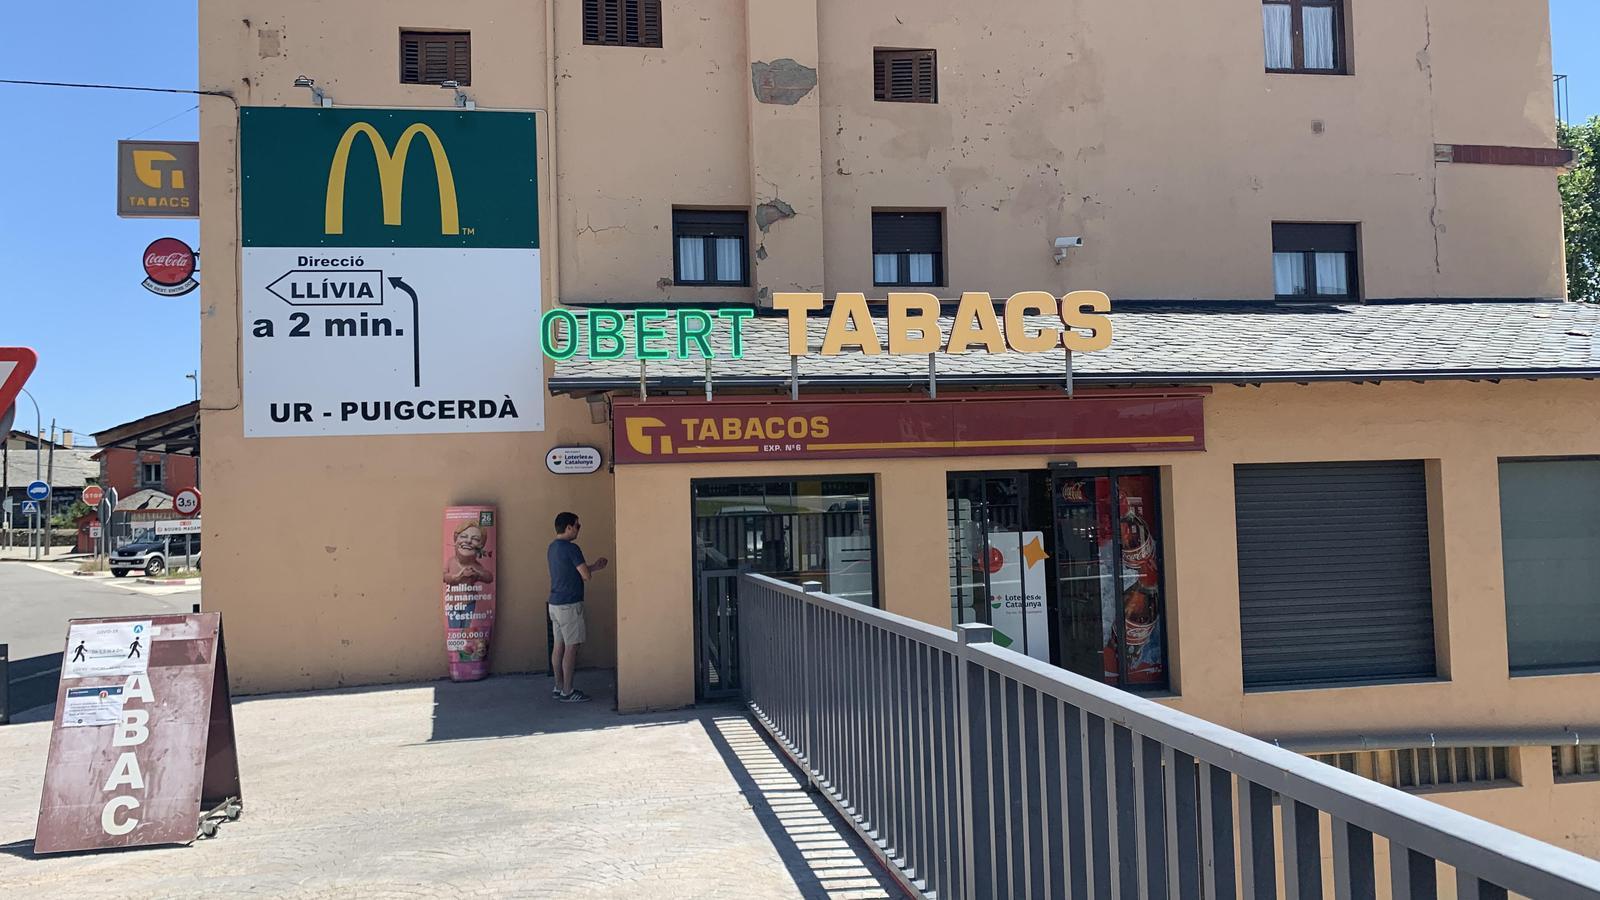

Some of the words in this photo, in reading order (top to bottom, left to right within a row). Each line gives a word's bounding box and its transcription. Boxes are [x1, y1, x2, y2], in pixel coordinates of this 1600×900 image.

[128, 196, 190, 209] TABACS
[145, 252, 190, 267] Coca-Cola
[297, 254, 365, 268] Direcció
[290, 277, 374, 299] LLÍVIA
[252, 318, 275, 338] a
[288, 312, 311, 337] 2
[325, 312, 405, 337] min.
[773, 289, 1113, 356] TABACS
[540, 308, 754, 361] OBERT
[269, 402, 313, 423] UR
[340, 394, 519, 422] PUIGCERDÀ
[681, 416, 830, 441] TABACOS
[763, 444, 782, 452] EXP.
[445, 584, 451, 592] 2
[451, 583, 483, 592] milions
[445, 593, 454, 602] de
[454, 594, 492, 602] maneres
[445, 602, 454, 611] de
[454, 602, 467, 611] dir
[1005, 601, 1042, 609] Cataunya
